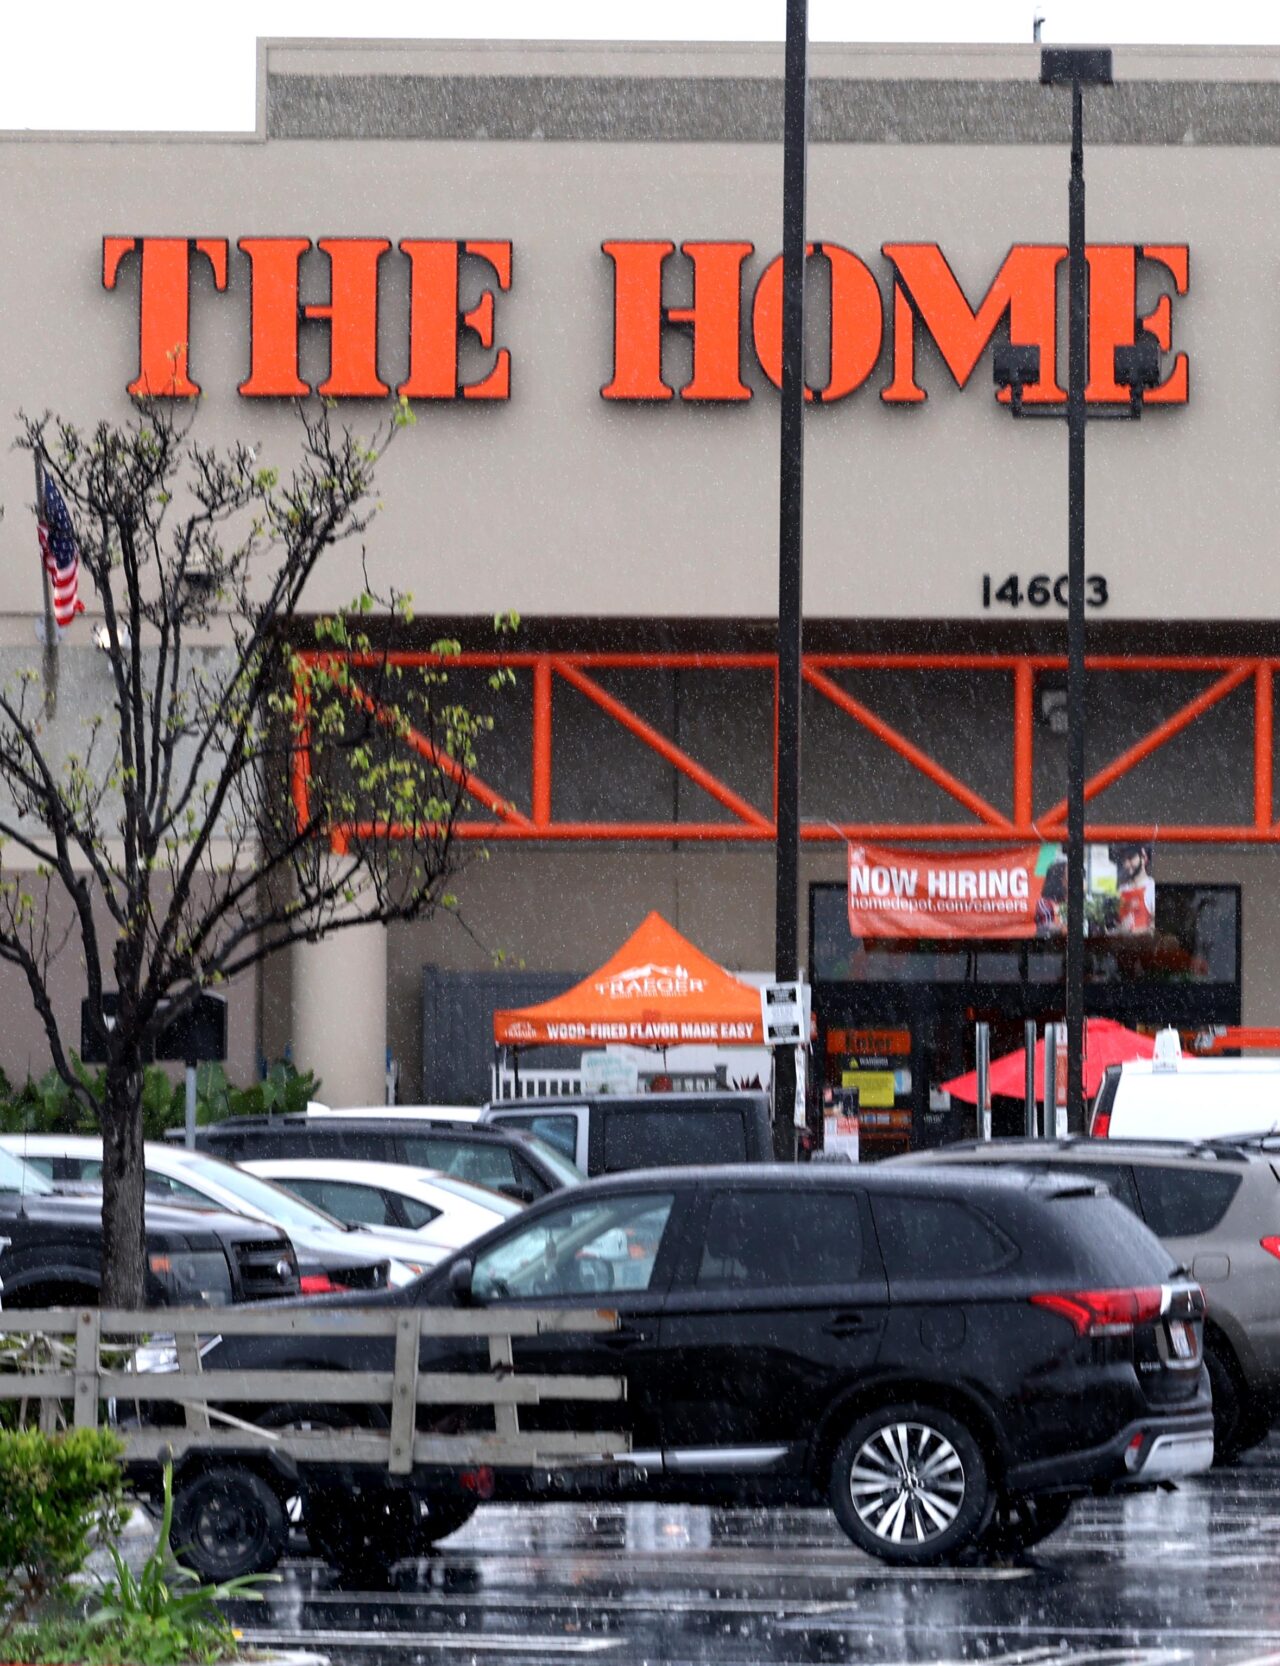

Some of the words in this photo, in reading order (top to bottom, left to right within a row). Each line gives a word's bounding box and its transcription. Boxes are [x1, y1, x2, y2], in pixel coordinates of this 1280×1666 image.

[102, 235, 513, 400] THE
[599, 239, 1191, 405] HOME
[850, 864, 919, 898] NOW
[927, 866, 1029, 900] HIRING
[851, 896, 1028, 914] homedepot.com/careers
[546, 1022, 628, 1040] WOOD-FIRED
[629, 1021, 679, 1040] FLAVOR
[680, 1021, 719, 1040] MADE
[720, 1022, 754, 1040] EASY
